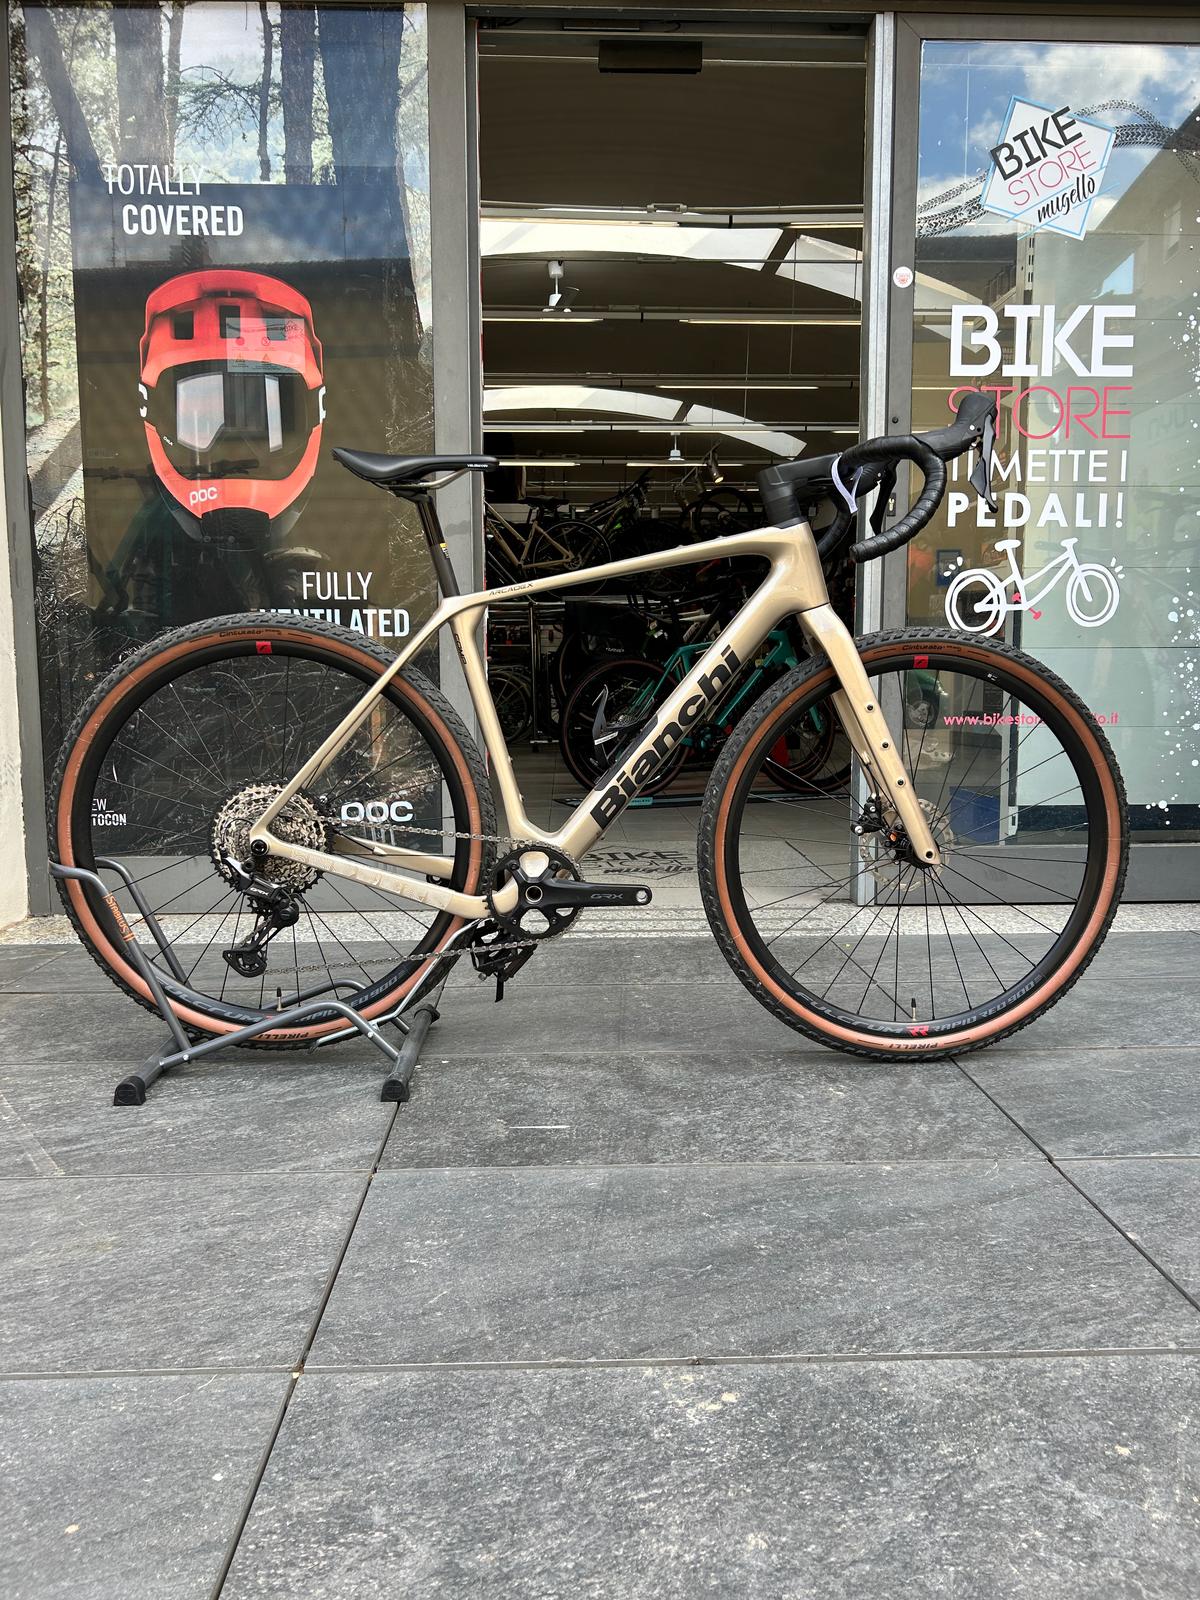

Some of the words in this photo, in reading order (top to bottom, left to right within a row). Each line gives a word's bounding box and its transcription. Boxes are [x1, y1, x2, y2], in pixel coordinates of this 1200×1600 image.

[990, 106, 1083, 181] BIKE
[102, 164, 205, 196] TOTALLY
[1008, 140, 1097, 206] STORE
[1036, 173, 1096, 223] mugello
[122, 204, 244, 236] COVERED
[949, 304, 1137, 377] BIKE
[990, 449, 1109, 482] METTE
[1120, 449, 1128, 482] I
[947, 491, 1125, 529] PEDALI!
[302, 571, 373, 600] FULLY
[589, 643, 742, 830] Bianchi
[888, 1041, 939, 1050] PIRELLI
